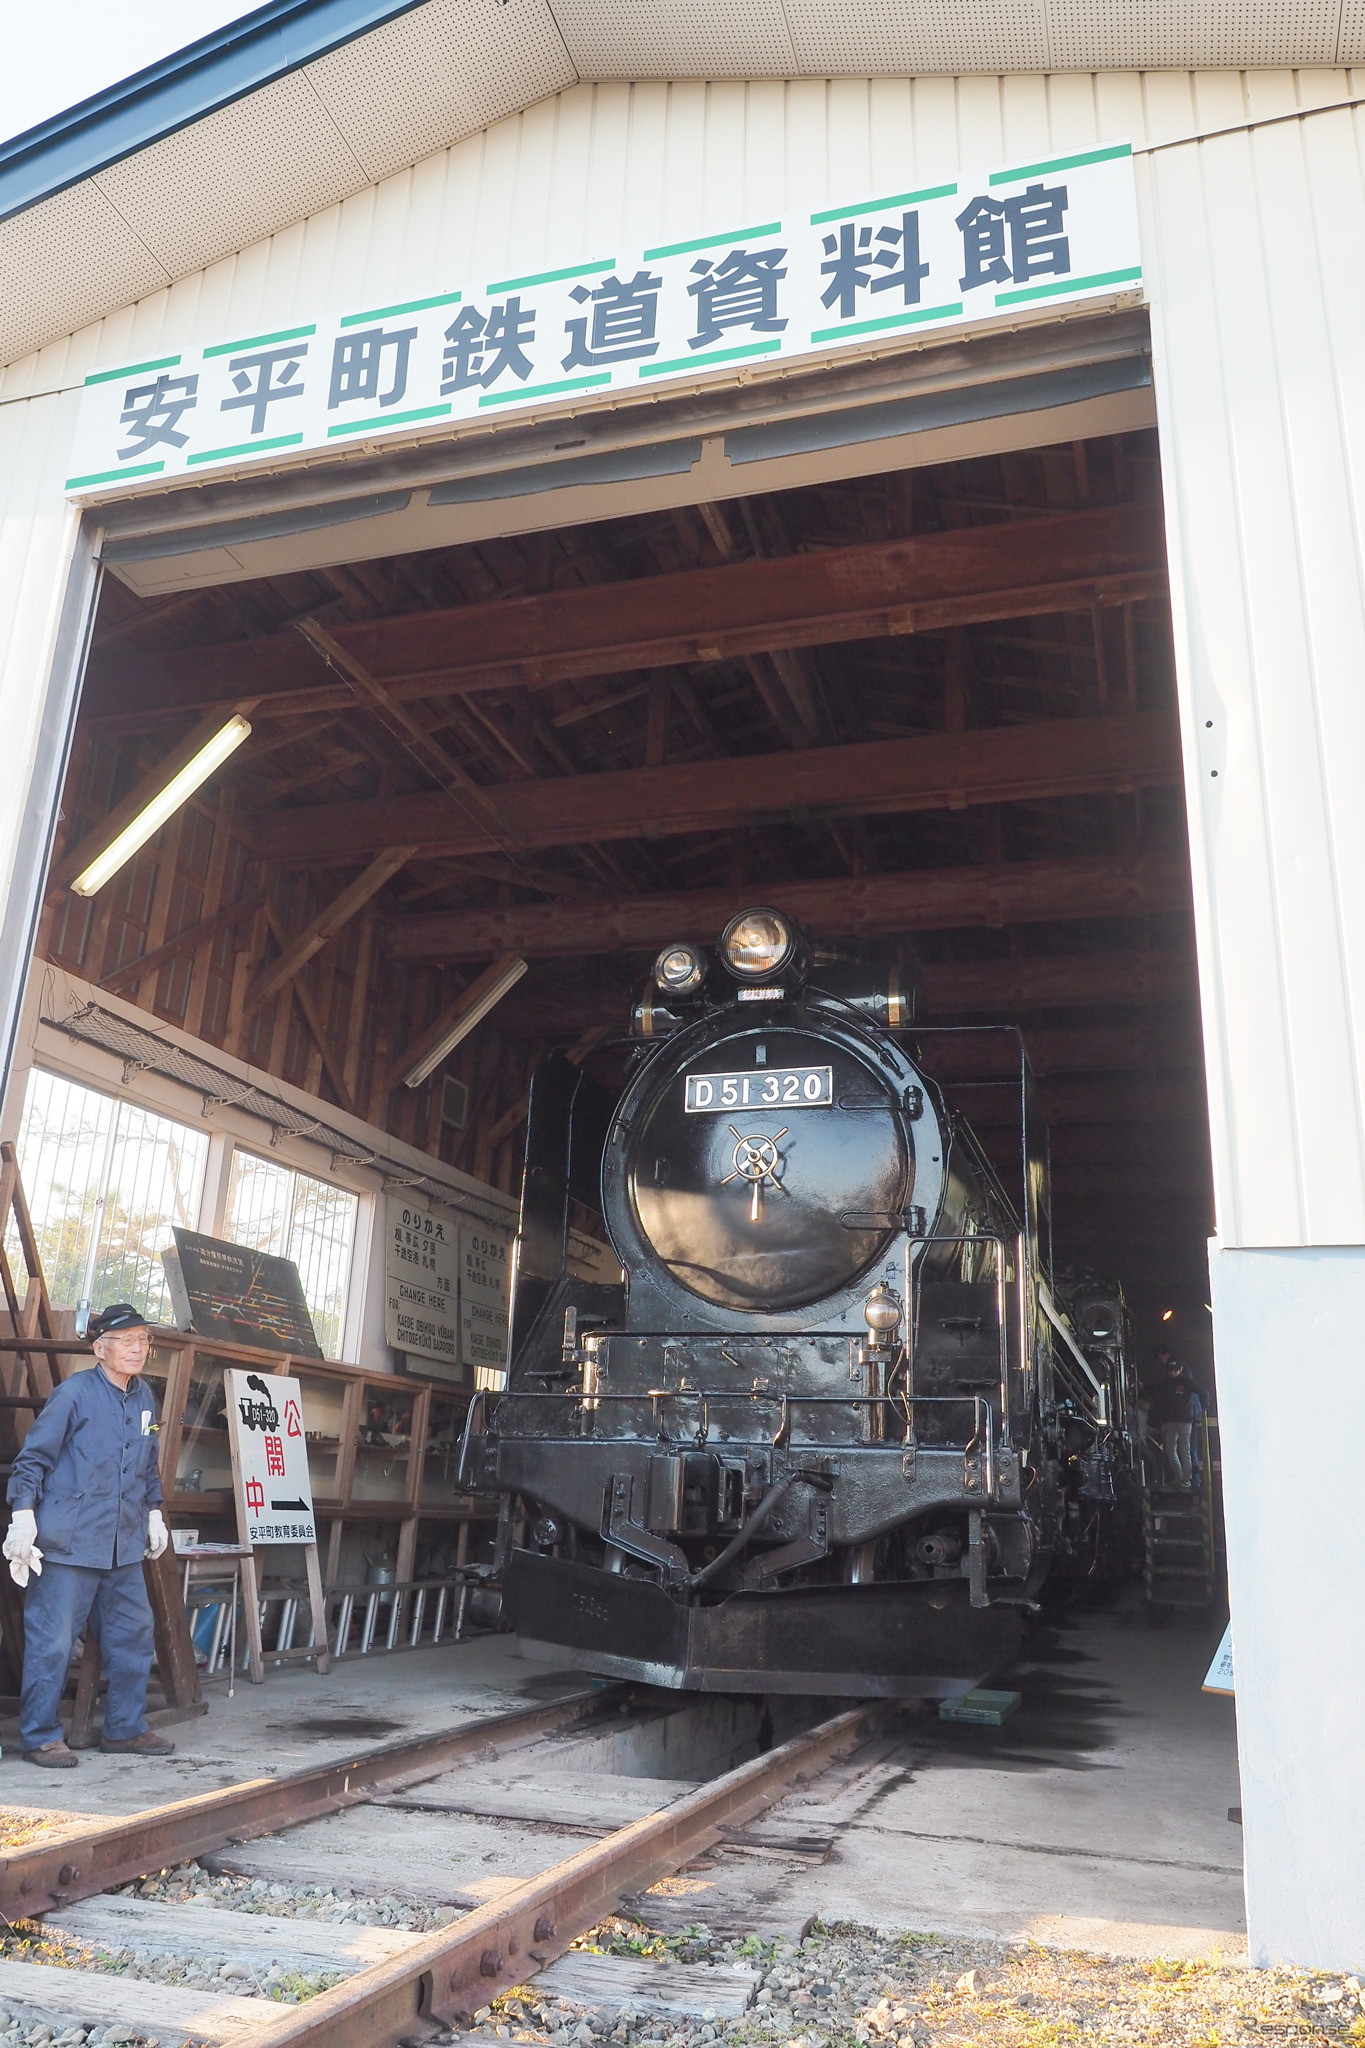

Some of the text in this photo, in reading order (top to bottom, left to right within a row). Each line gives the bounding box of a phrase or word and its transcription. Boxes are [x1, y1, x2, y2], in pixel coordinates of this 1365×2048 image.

[116, 183, 1070, 459] 安平町鉄道資料館
[761, 1074, 822, 1103] 320
[402, 1209, 445, 1241] のりかえ
[472, 1236, 506, 1262] のりかえ
[400, 1285, 446, 1310] CHANGE HERE
[252, 1407, 276, 1423] D51-320
[249, 1524, 314, 1540] 安平町教育委員会
